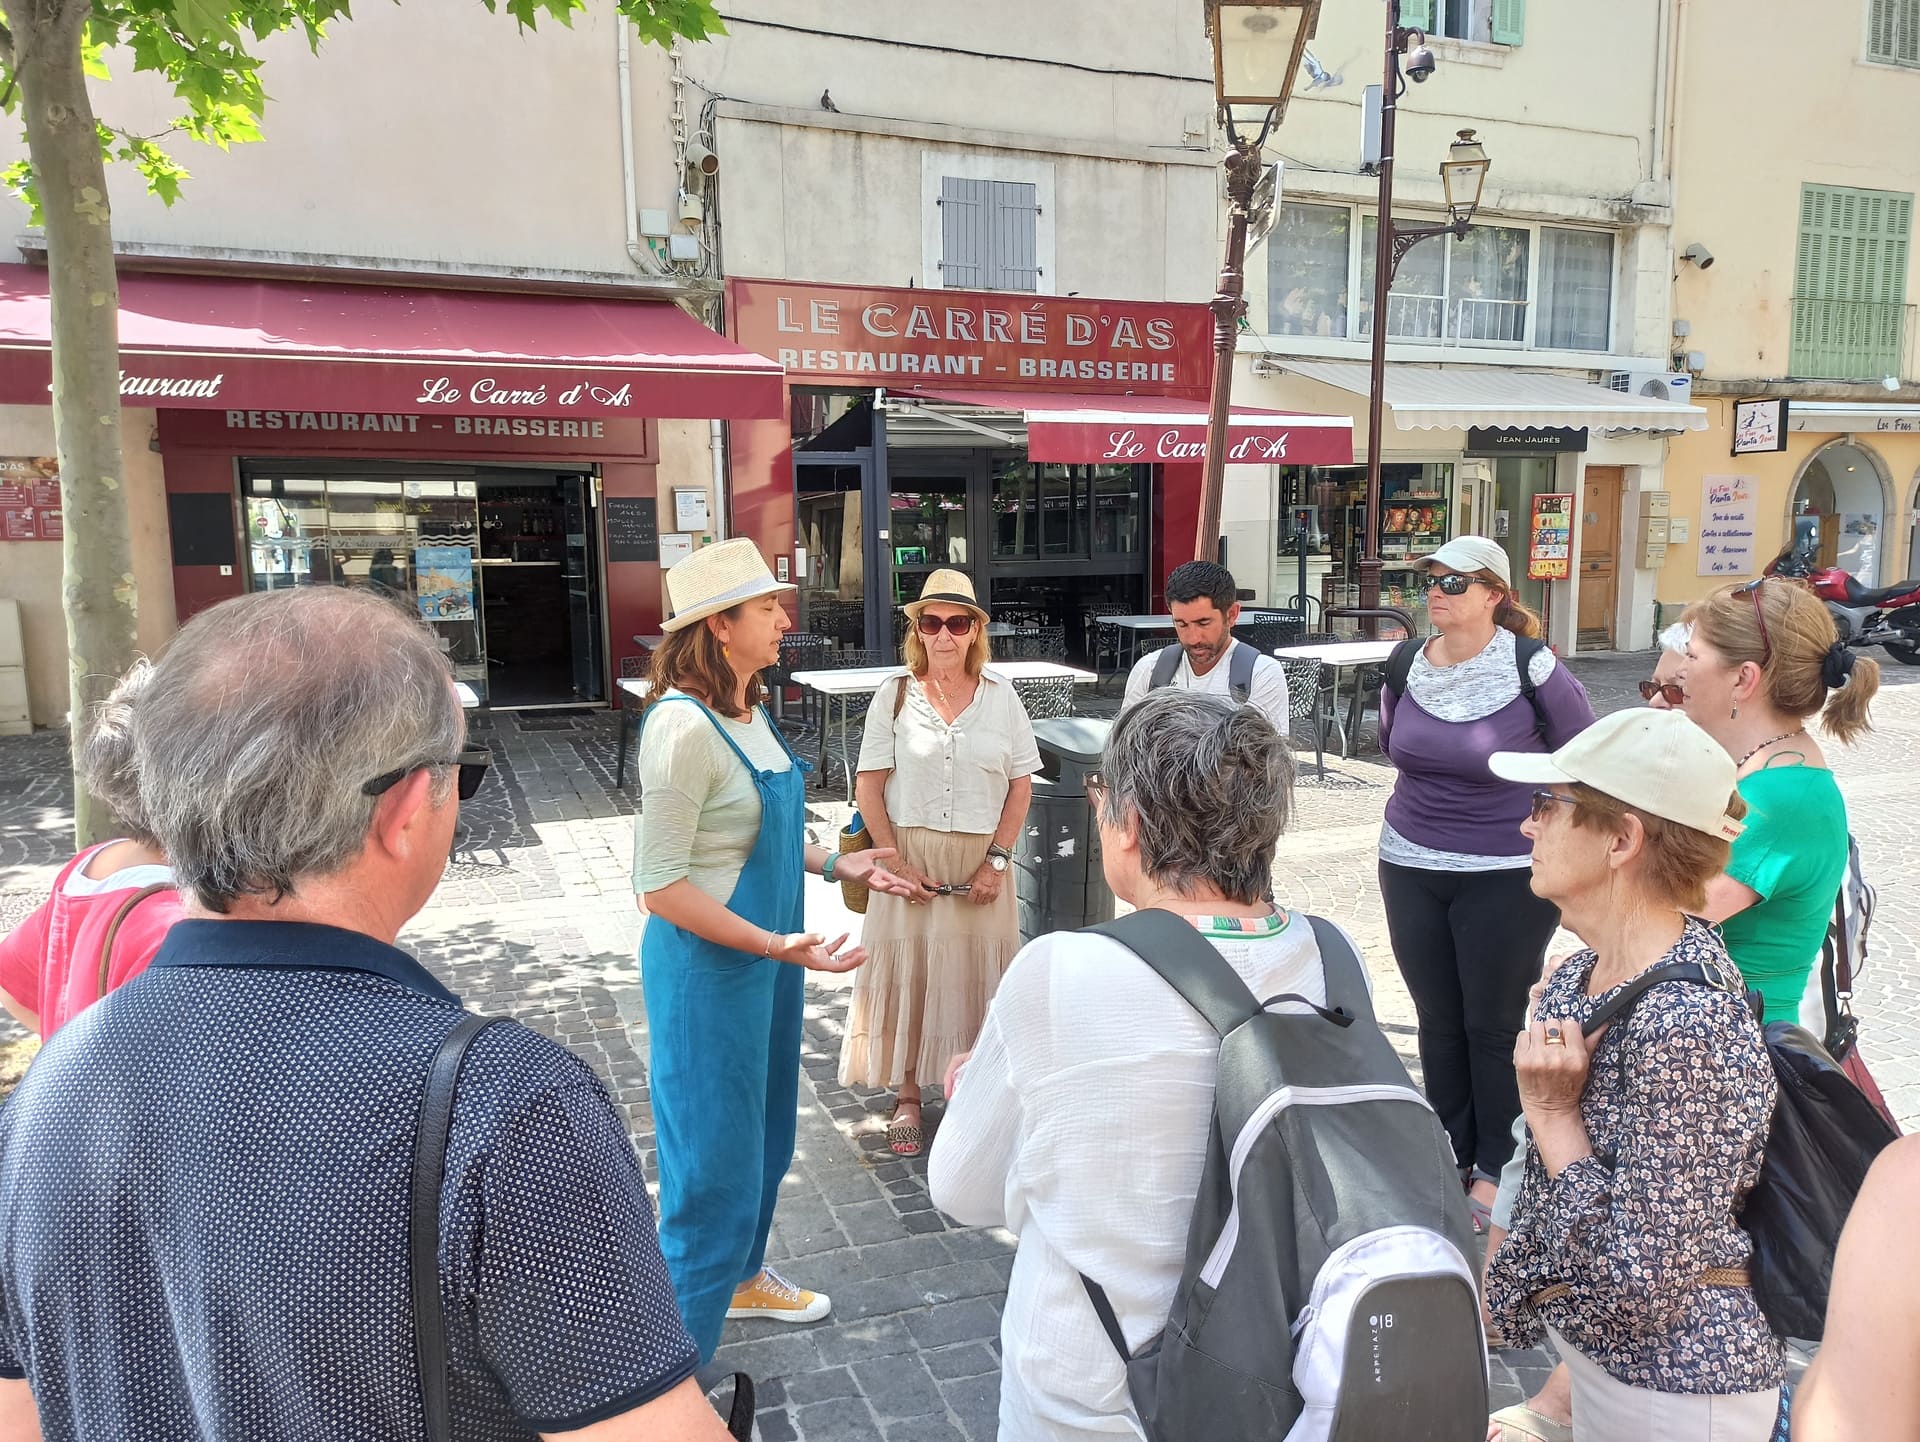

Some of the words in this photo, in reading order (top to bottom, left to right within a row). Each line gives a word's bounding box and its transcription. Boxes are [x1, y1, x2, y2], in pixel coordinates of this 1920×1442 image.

[777, 297, 840, 335] LE
[861, 303, 1048, 345] CARRÉ
[1066, 313, 1177, 351] D'AS
[778, 348, 984, 376] RESTAURANT
[1020, 358, 1175, 382] BRASSERIE
[416, 377, 461, 404] Le
[469, 378, 549, 406] Carré
[558, 382, 633, 407] d'As
[226, 409, 420, 433] RESTAURANT
[455, 417, 605, 438] BRASSERIE
[1103, 430, 1146, 458] Le
[1157, 430, 1208, 458] Carr
[1229, 432, 1290, 459] d'As
[1525, 434, 1560, 444] JAURÈS
[1371, 1328, 1382, 1383] ARPENAZ
